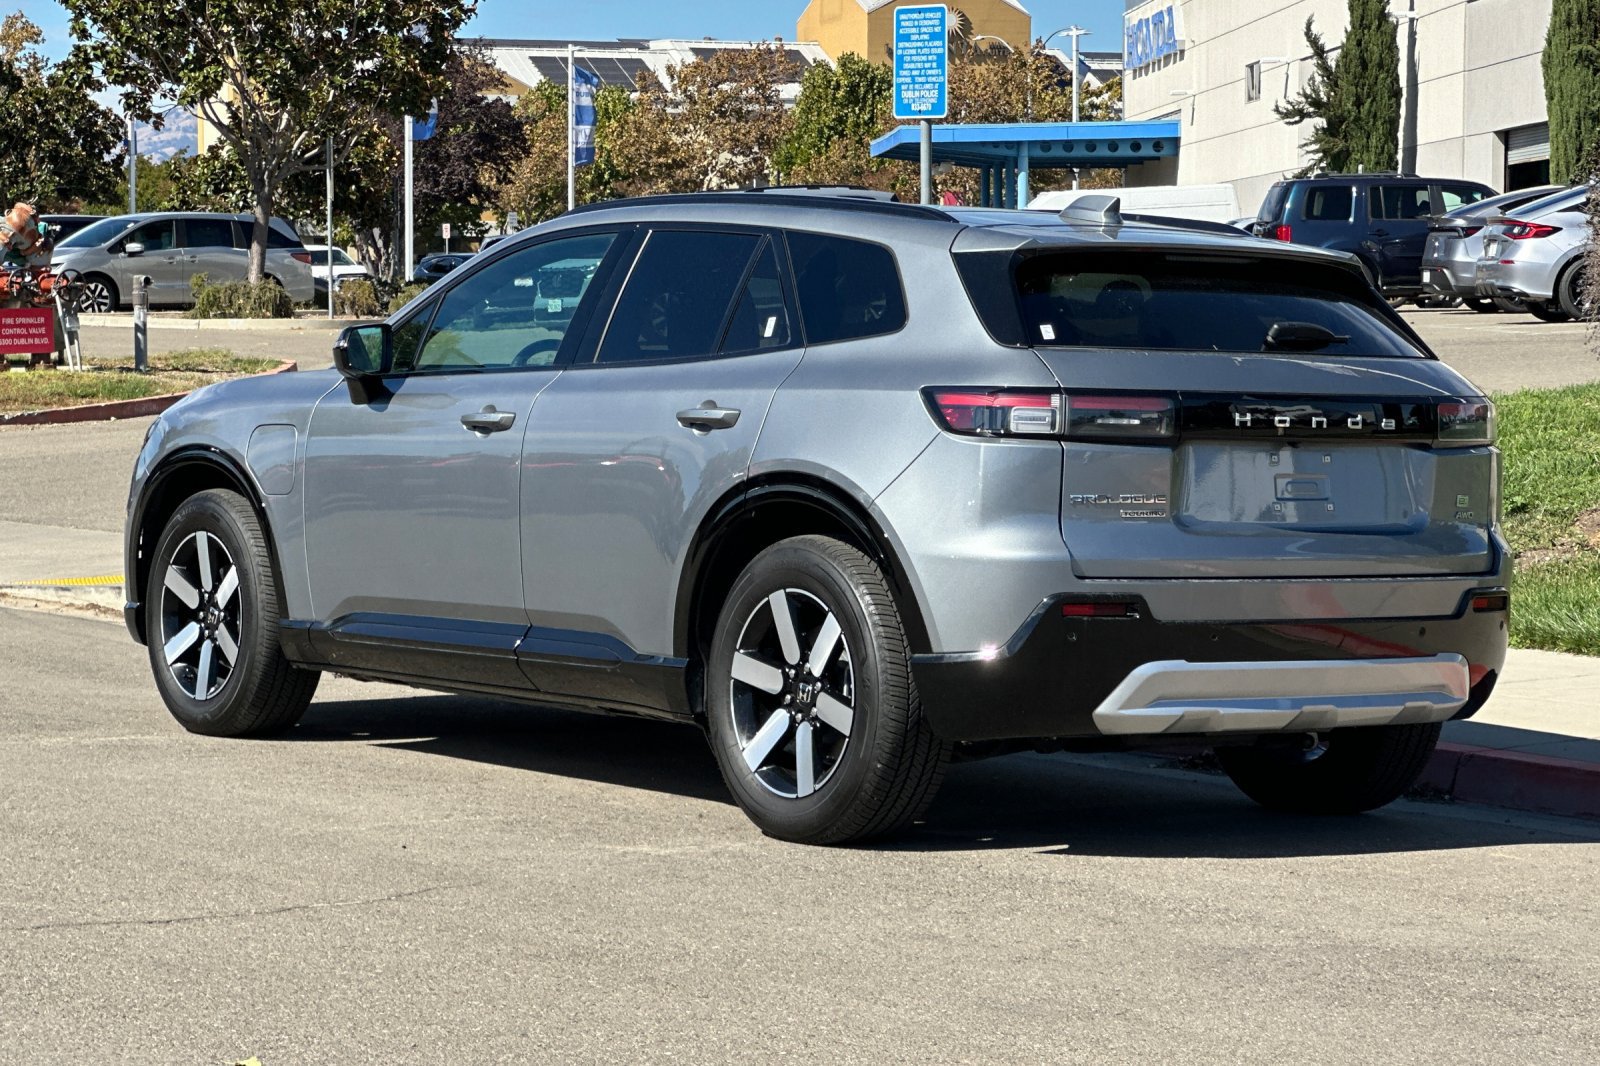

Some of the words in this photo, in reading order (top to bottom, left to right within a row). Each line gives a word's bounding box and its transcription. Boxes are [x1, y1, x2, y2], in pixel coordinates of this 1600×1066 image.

[1125, 5, 1177, 70] HONDA
[920, 90, 939, 98] POLICE
[1235, 412, 1396, 430] Honda
[1069, 494, 1166, 504] PROLOGUE
[1122, 510, 1166, 518] TOURING
[1455, 511, 1473, 520] AWD
